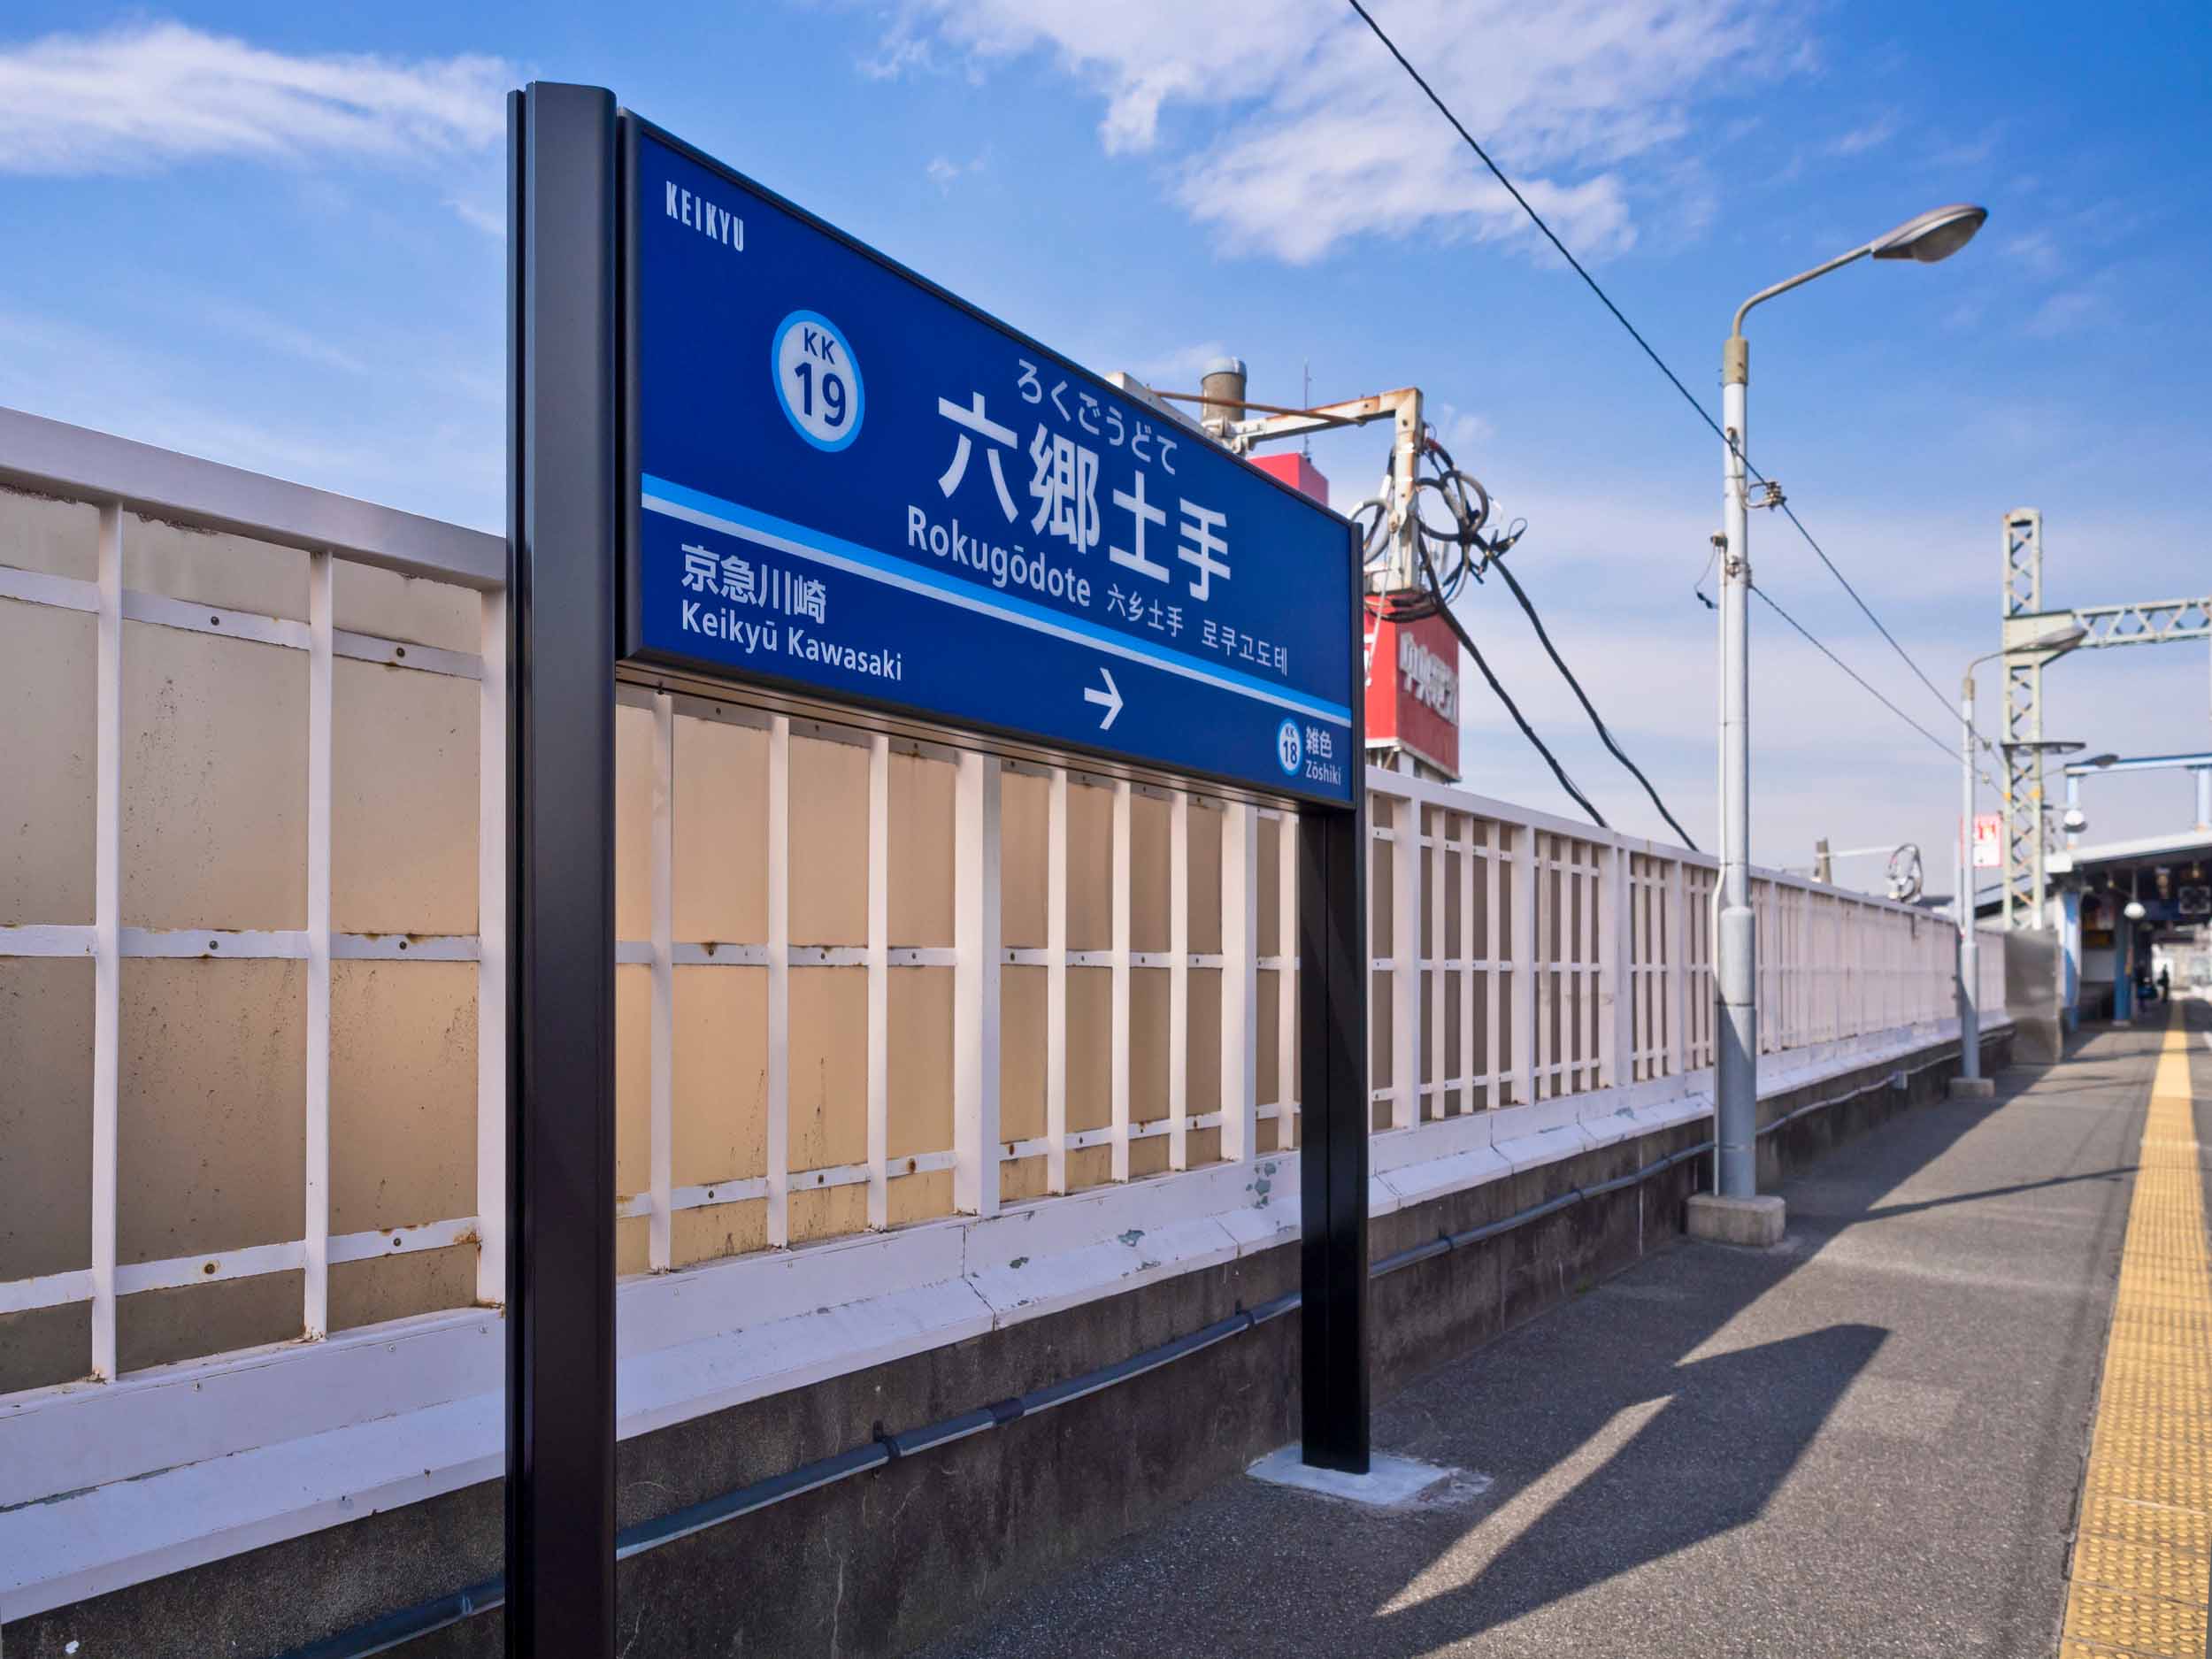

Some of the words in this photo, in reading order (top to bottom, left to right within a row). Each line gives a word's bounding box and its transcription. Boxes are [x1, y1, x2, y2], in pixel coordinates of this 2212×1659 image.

[665, 180, 744, 252] KEIKYU
[803, 327, 836, 365] KK
[795, 362, 846, 427] 19
[1018, 358, 1178, 475] ろくごうどて
[938, 391, 1231, 602] 六郷土手
[681, 543, 826, 625] 京急川崎
[908, 504, 1091, 607] Rokugōdote
[681, 599, 778, 654] Keikyū
[788, 626, 902, 681] Kawasaki
[1107, 583, 1184, 637] 六乡土手
[1202, 619, 1288, 677] 로쿠고도테
[1283, 741, 1297, 764] 18
[1305, 726, 1333, 759] 雑色
